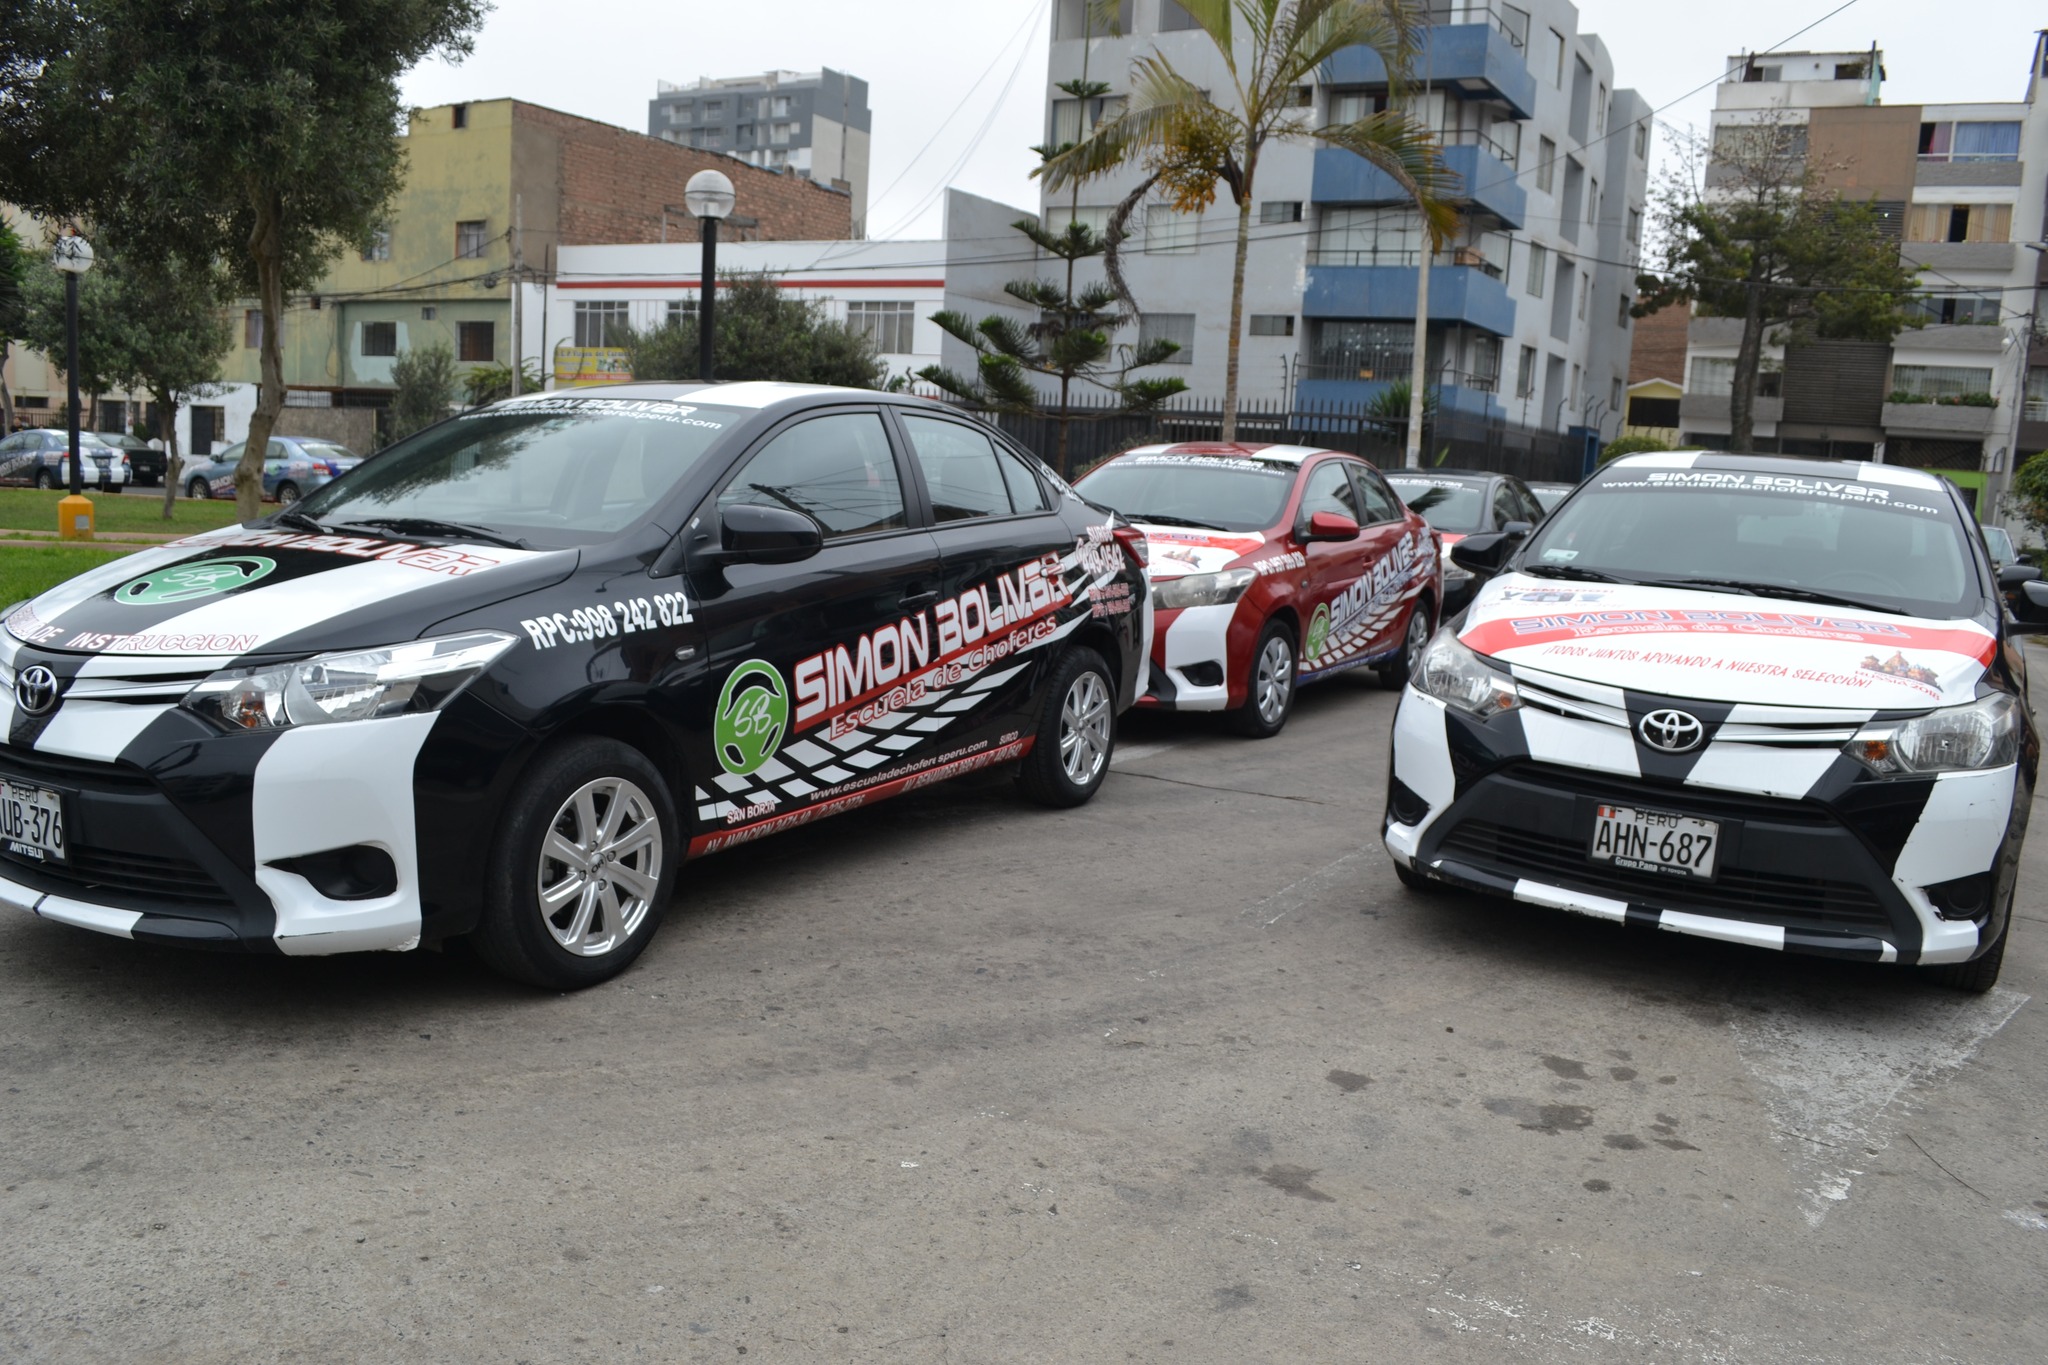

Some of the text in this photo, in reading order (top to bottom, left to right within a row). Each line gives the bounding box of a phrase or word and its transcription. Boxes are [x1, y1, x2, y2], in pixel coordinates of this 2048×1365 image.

[578, 399, 697, 418] BOLIVAR
[1135, 455, 1266, 468] SIMON BOLIVAR
[1602, 479, 1938, 515] www.escueladechoferesperu.com
[1647, 473, 1889, 499] SIMON BOLIVAR
[1330, 573, 1373, 630] SIMON
[520, 591, 694, 650] RPC:998 242 822
[1511, 610, 1911, 638] SIMON BOLIVAR
[65, 632, 258, 651] INSTRUCCION
[794, 550, 1072, 723] SIMON BOLIVAR
[1588, 648, 1640, 661] JUNTOS
[1641, 653, 1711, 668] APOYANDO
[1712, 659, 1722, 669] A
[1726, 660, 1787, 677] NUESTRA
[830, 615, 1058, 741] Escuela de Choferes
[0, 798, 63, 849] UB-376
[727, 800, 776, 825] SAN BORJA
[1635, 812, 1678, 829] PERU
[10, 841, 44, 859] MITSUI
[1596, 820, 1713, 868] AHN-687
[1615, 856, 1637, 868] Grupo
[1639, 860, 1658, 872] Pana
